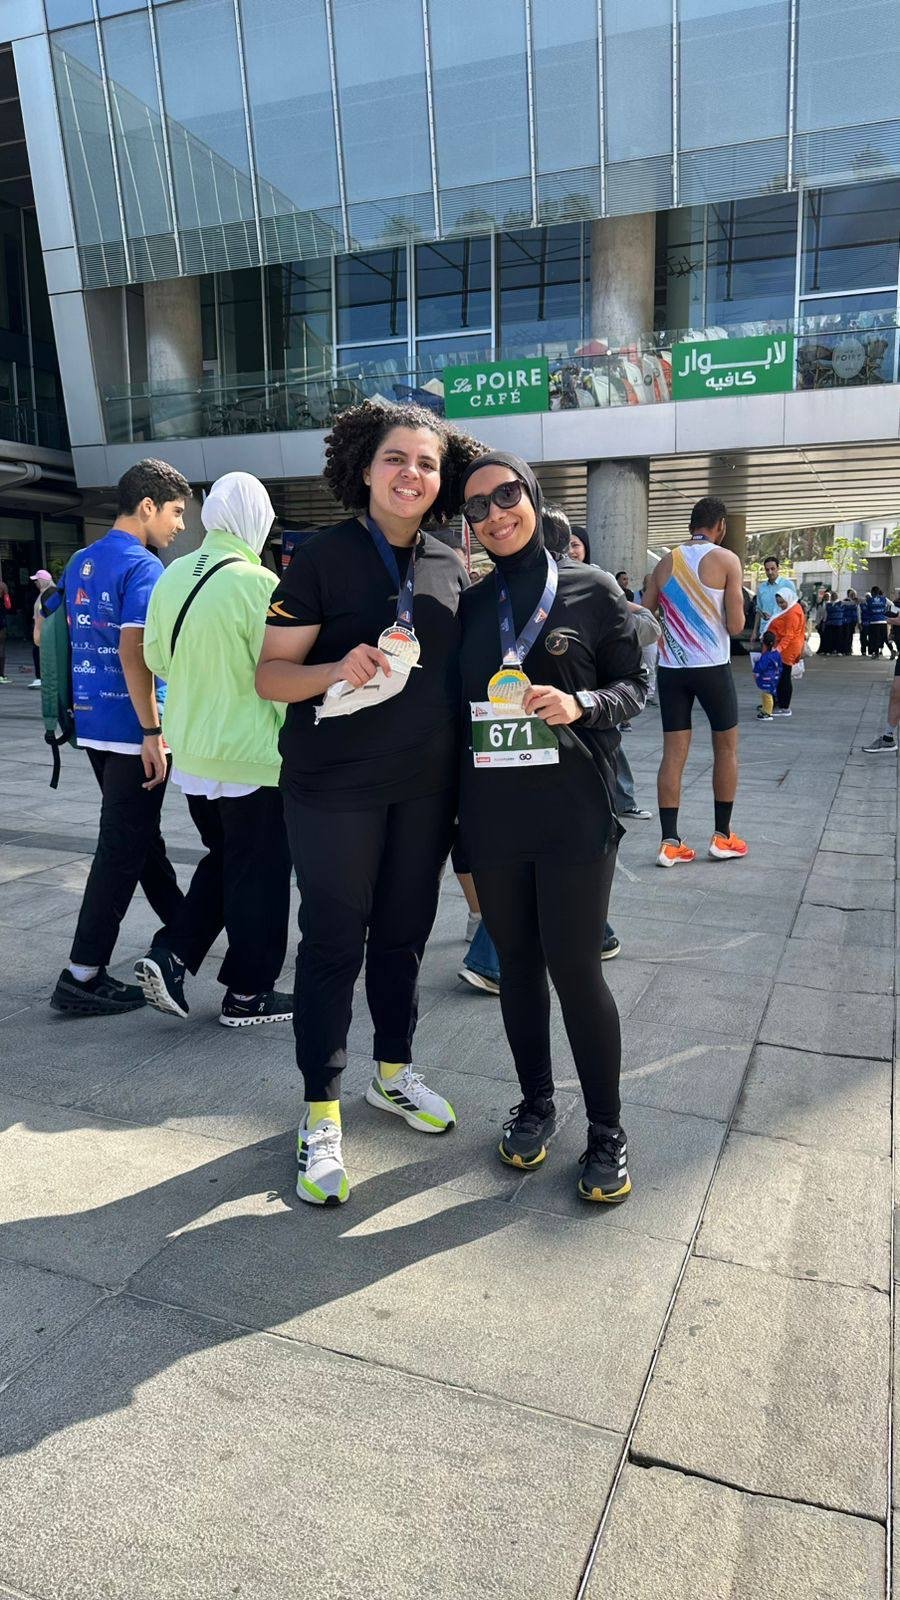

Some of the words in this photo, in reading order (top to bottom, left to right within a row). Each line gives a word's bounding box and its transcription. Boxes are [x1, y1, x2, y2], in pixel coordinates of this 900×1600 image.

[450, 378, 472, 394] La
[476, 368, 542, 391] POIRE
[705, 370, 757, 391] كافيه
[470, 388, 520, 407] CAFÉ
[489, 721, 533, 748] 671
[519, 753, 532, 761] GO
